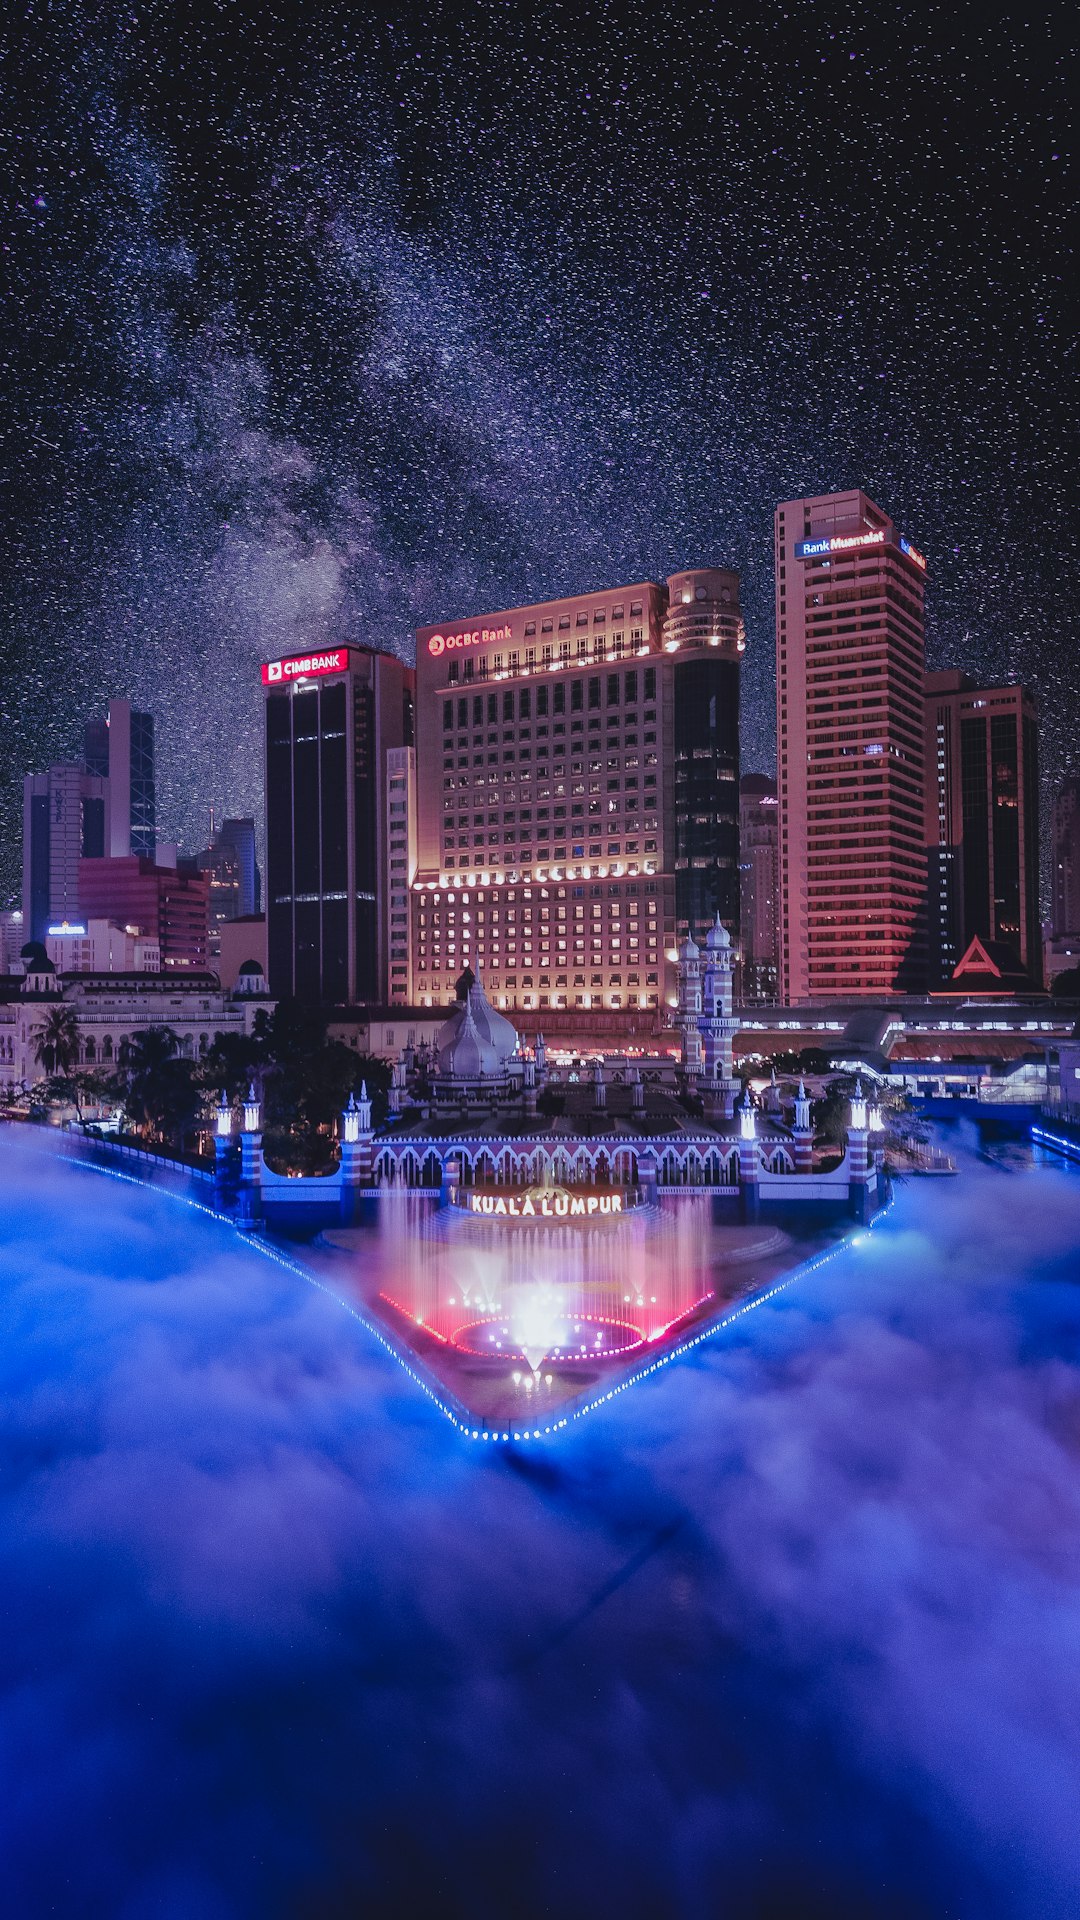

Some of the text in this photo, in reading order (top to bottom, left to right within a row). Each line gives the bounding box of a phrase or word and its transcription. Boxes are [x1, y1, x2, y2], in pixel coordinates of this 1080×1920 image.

[803, 530, 884, 554] Bank Muamalat
[446, 625, 511, 649] OCBC Bank
[472, 1194, 622, 1216] KUALA LUMPUR
